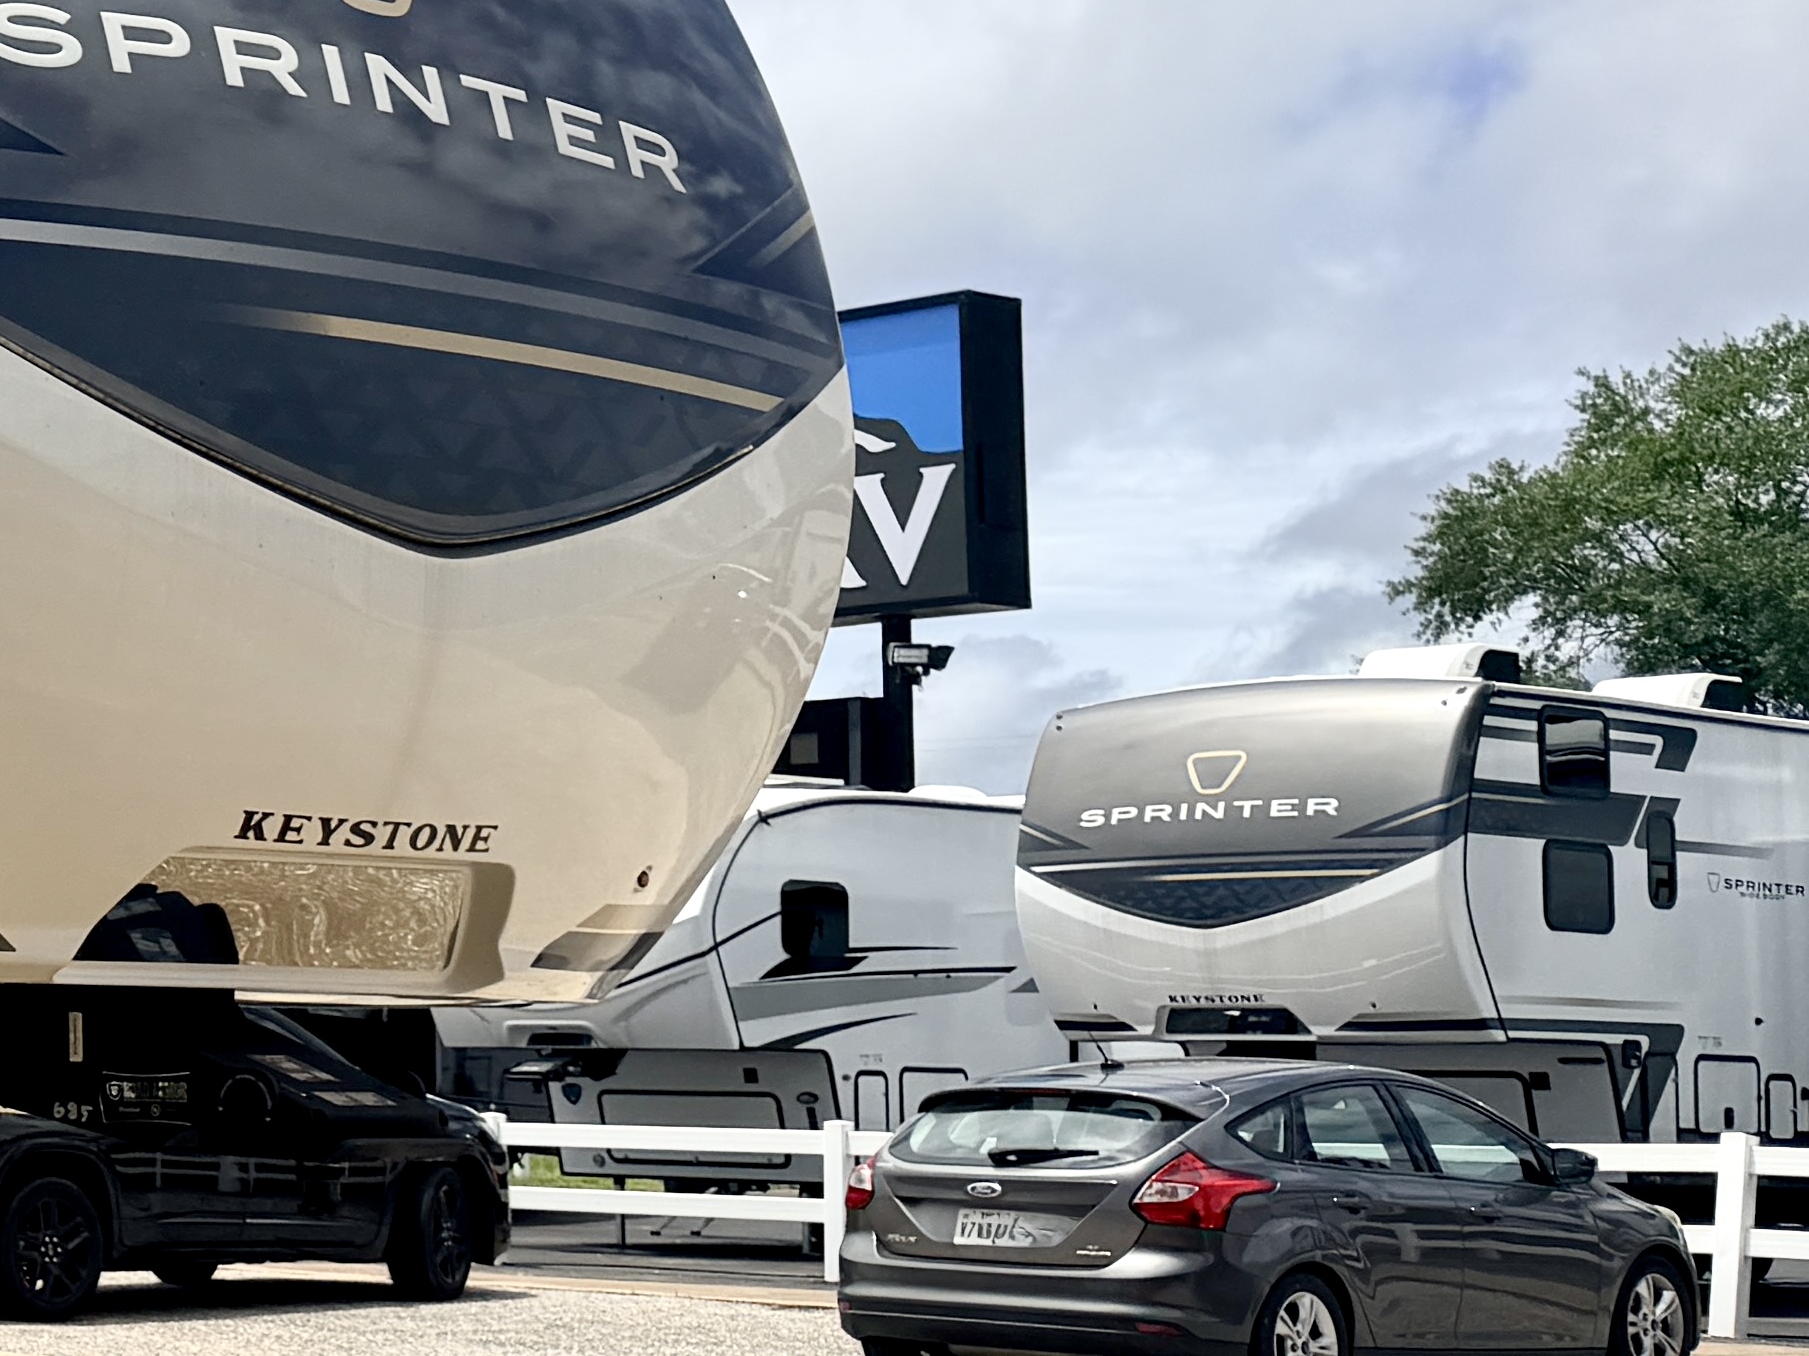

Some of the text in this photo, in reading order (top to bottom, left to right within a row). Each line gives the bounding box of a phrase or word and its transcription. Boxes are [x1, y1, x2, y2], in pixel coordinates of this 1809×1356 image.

[840, 462, 957, 589] V
[1079, 797, 1340, 828] SPRINTER
[233, 809, 499, 854] KEYSTONE
[1723, 877, 1806, 897] SPRINTER
[1168, 993, 1266, 1004] KEYSTONE
[53, 1101, 94, 1123] 685
